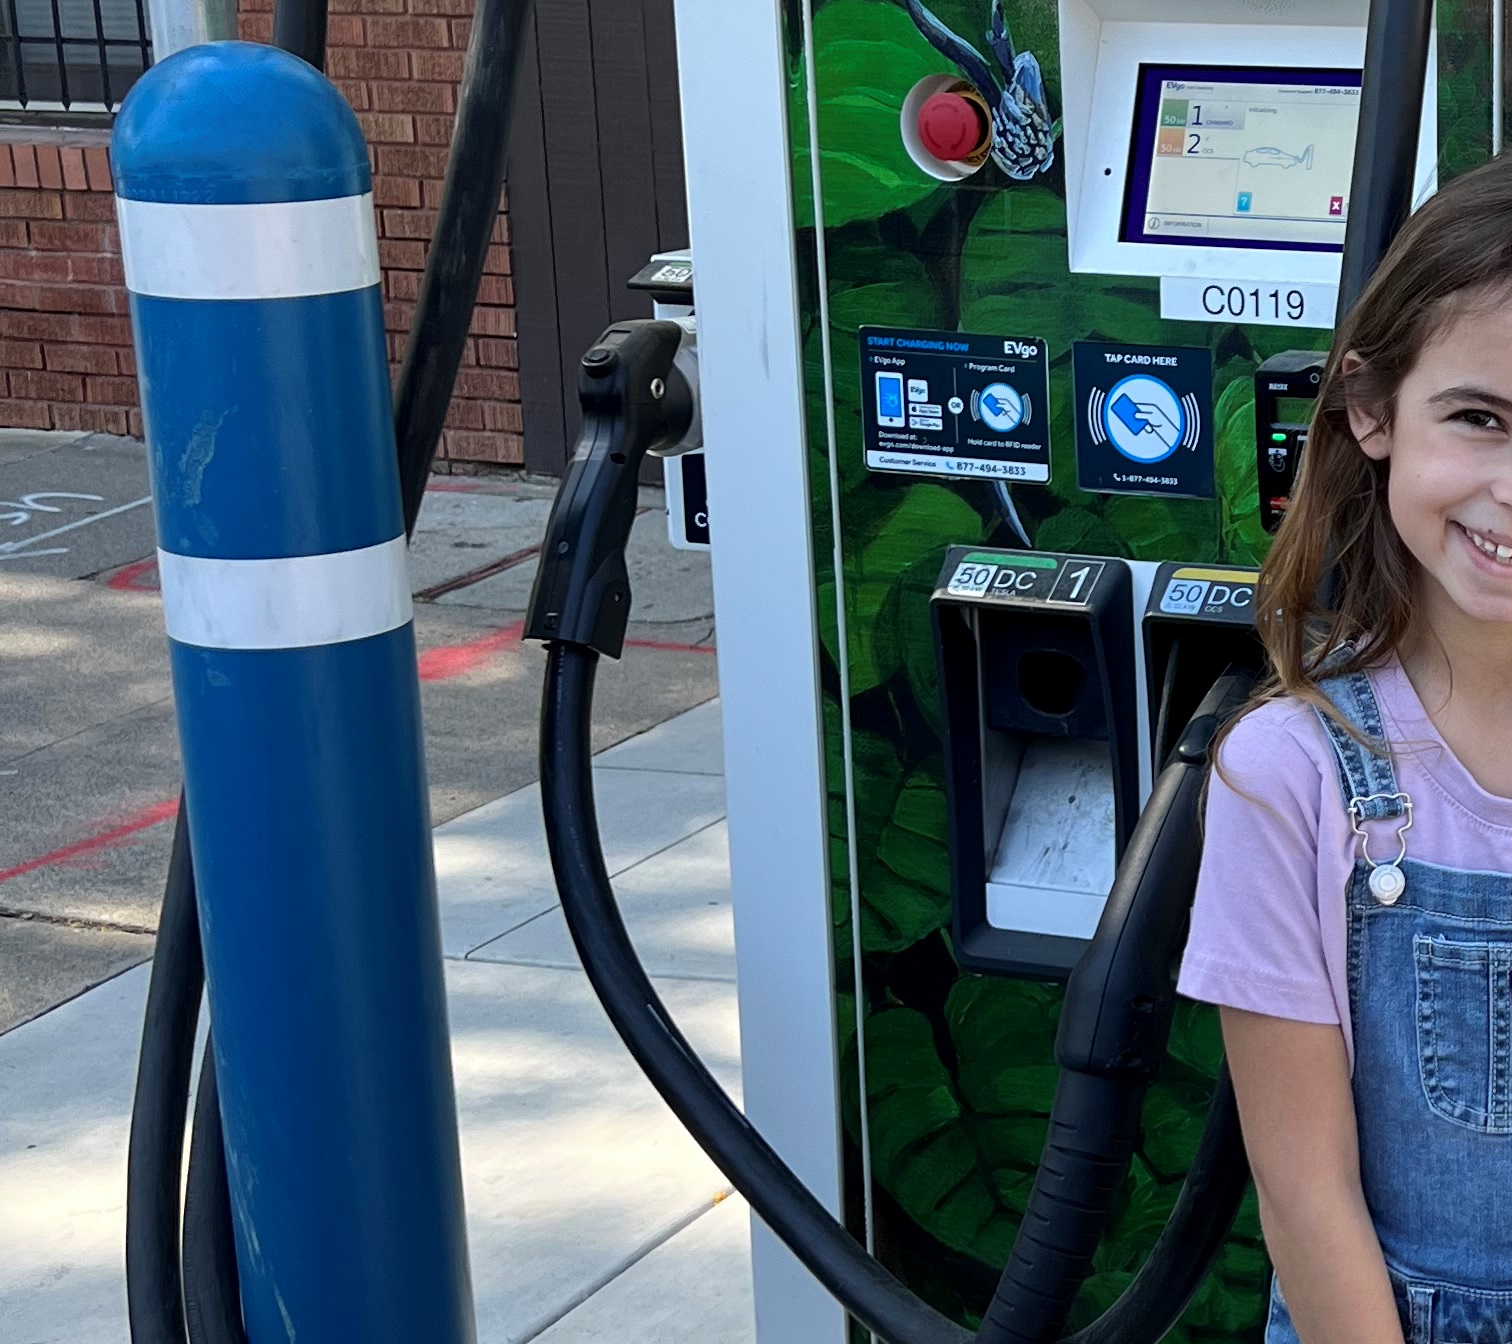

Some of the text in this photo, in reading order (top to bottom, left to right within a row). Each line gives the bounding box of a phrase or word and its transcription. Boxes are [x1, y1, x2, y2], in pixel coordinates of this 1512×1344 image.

[1191, 105, 1203, 126] 1
[1186, 133, 1201, 154] 2
[1202, 285, 1305, 321] C0119
[867, 337, 969, 352] START CHARGING NOW
[1003, 340, 1038, 359] EVgo
[874, 356, 906, 366] EVgo App
[1104, 353, 1178, 367] TAP CARD HERE
[968, 362, 1016, 374] Program Card
[950, 401, 961, 409] OR
[878, 431, 909, 441] Download
[967, 438, 982, 446] Hold
[983, 439, 997, 447] card
[1021, 442, 1042, 450] reader
[878, 455, 937, 467] Customer Service
[956, 461, 1027, 476] 877-494-3833
[956, 567, 991, 586] 50
[993, 569, 1038, 590] DC
[1069, 566, 1091, 599] 1
[1168, 583, 1203, 603] 50
[1207, 585, 1254, 607] DC
[1204, 605, 1224, 613] CCS
